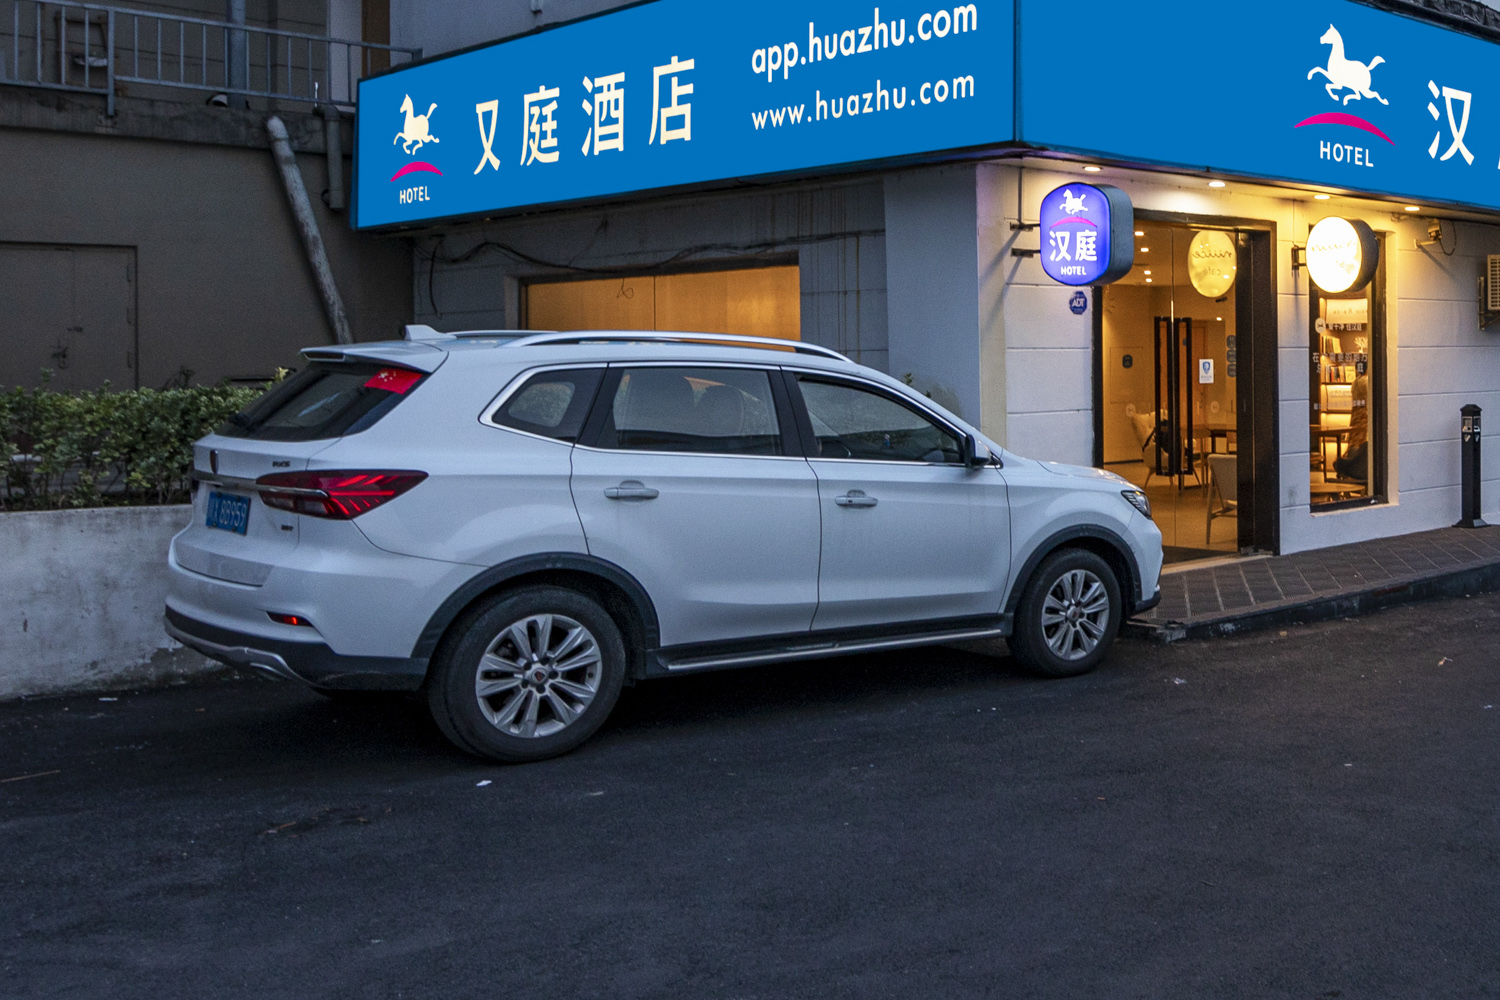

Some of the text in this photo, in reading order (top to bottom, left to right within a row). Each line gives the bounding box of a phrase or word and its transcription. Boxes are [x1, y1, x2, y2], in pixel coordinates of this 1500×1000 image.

[752, 4, 977, 82] app.huazhu.com
[752, 75, 974, 130] www.huazhu.com
[1320, 140, 1374, 167] HOTEL
[400, 186, 430, 204] HOTEL
[1049, 229, 1097, 262] 汉庭
[1060, 265, 1087, 276] HOTEL
[1071, 298, 1085, 307] ADT
